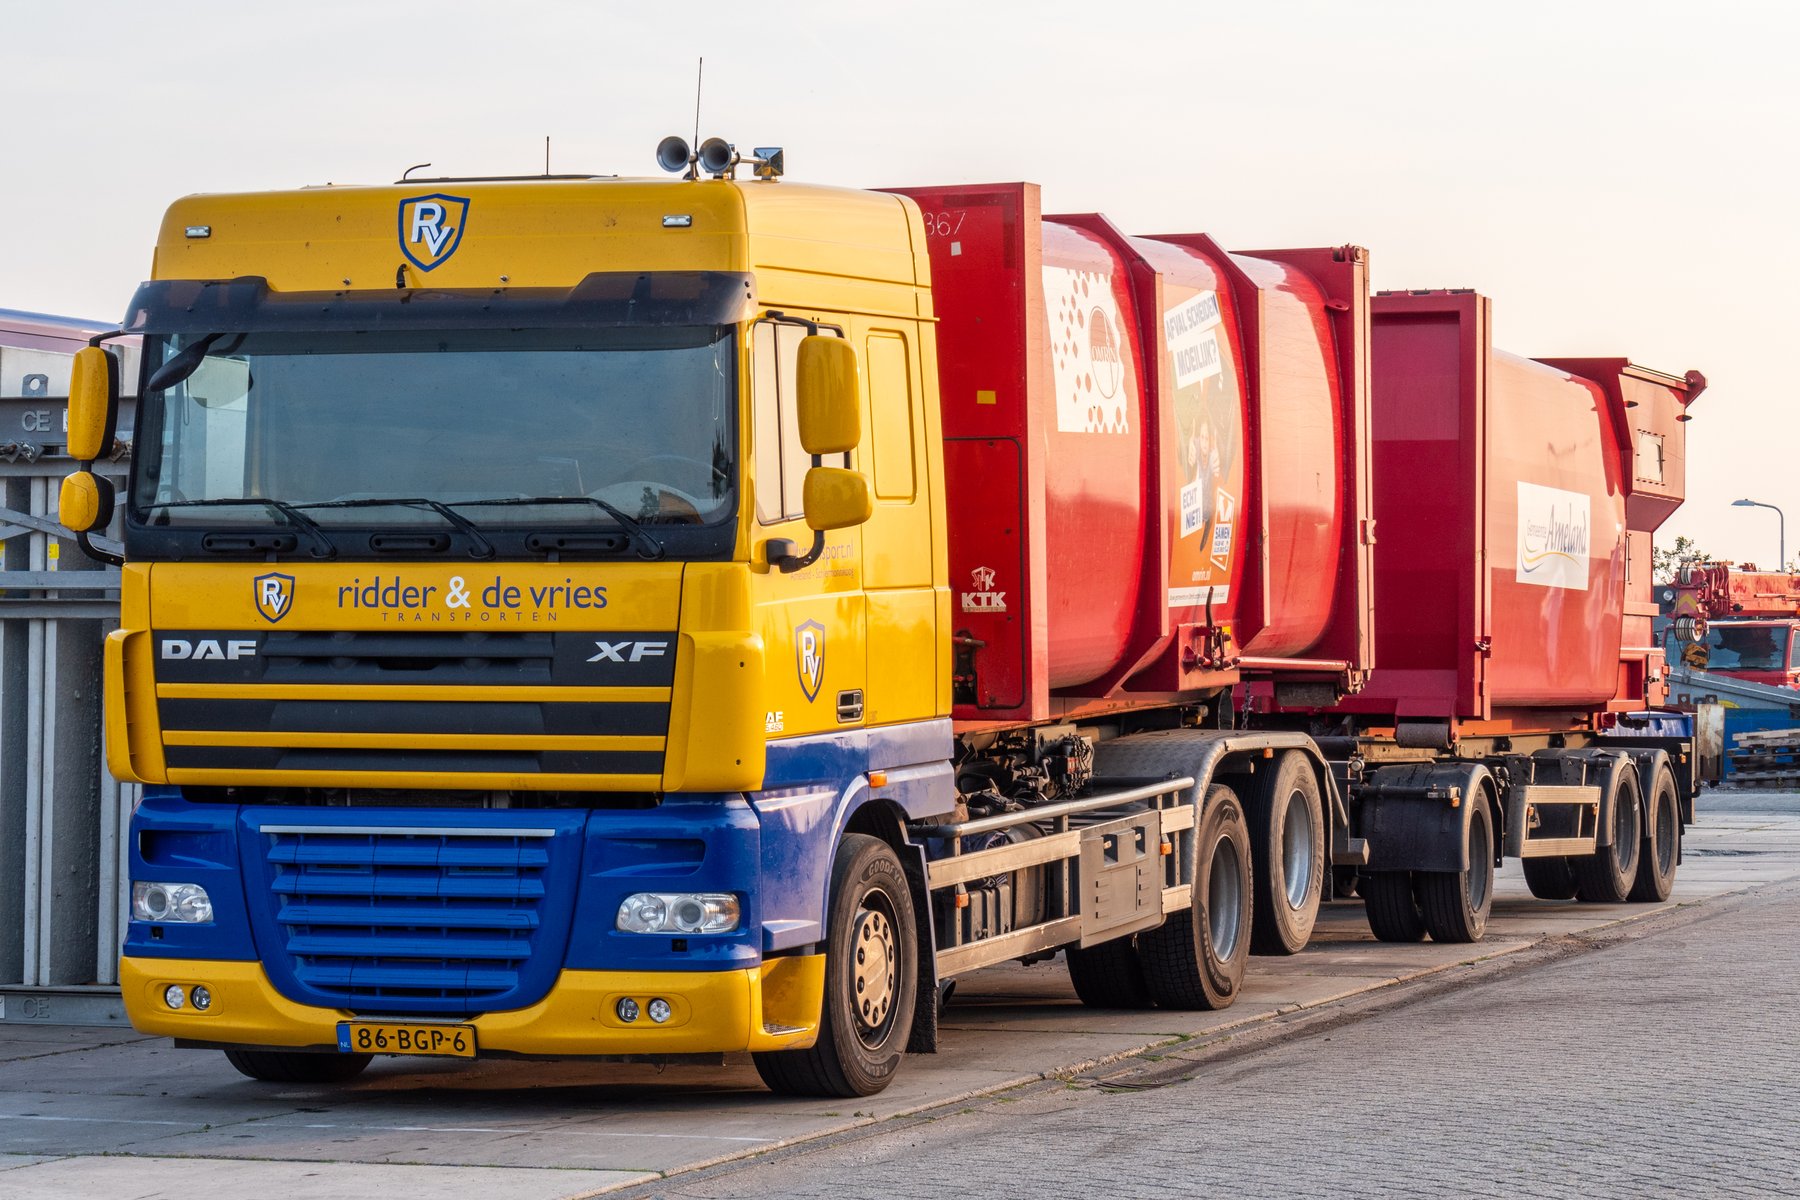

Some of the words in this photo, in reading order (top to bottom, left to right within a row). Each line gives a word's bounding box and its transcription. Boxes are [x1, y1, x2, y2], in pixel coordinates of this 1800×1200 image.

[1165, 311, 1189, 342] AFVAL
[1186, 293, 1219, 330] SCHEIDEN
[1176, 338, 1218, 377] MOEILIJK?
[22, 410, 51, 432] CE
[1182, 487, 1199, 510] ECHT
[1544, 502, 1587, 555] Ameland
[338, 576, 437, 608] ridder
[445, 576, 471, 609] &
[482, 576, 521, 609] de
[529, 578, 608, 609] vries
[961, 591, 1007, 608] KTK
[381, 612, 558, 622] TRANSPORTEN
[161, 639, 257, 660] DAF
[586, 641, 668, 662] XF
[765, 711, 784, 723] AF
[357, 1028, 467, 1052] 86-BGP-6
